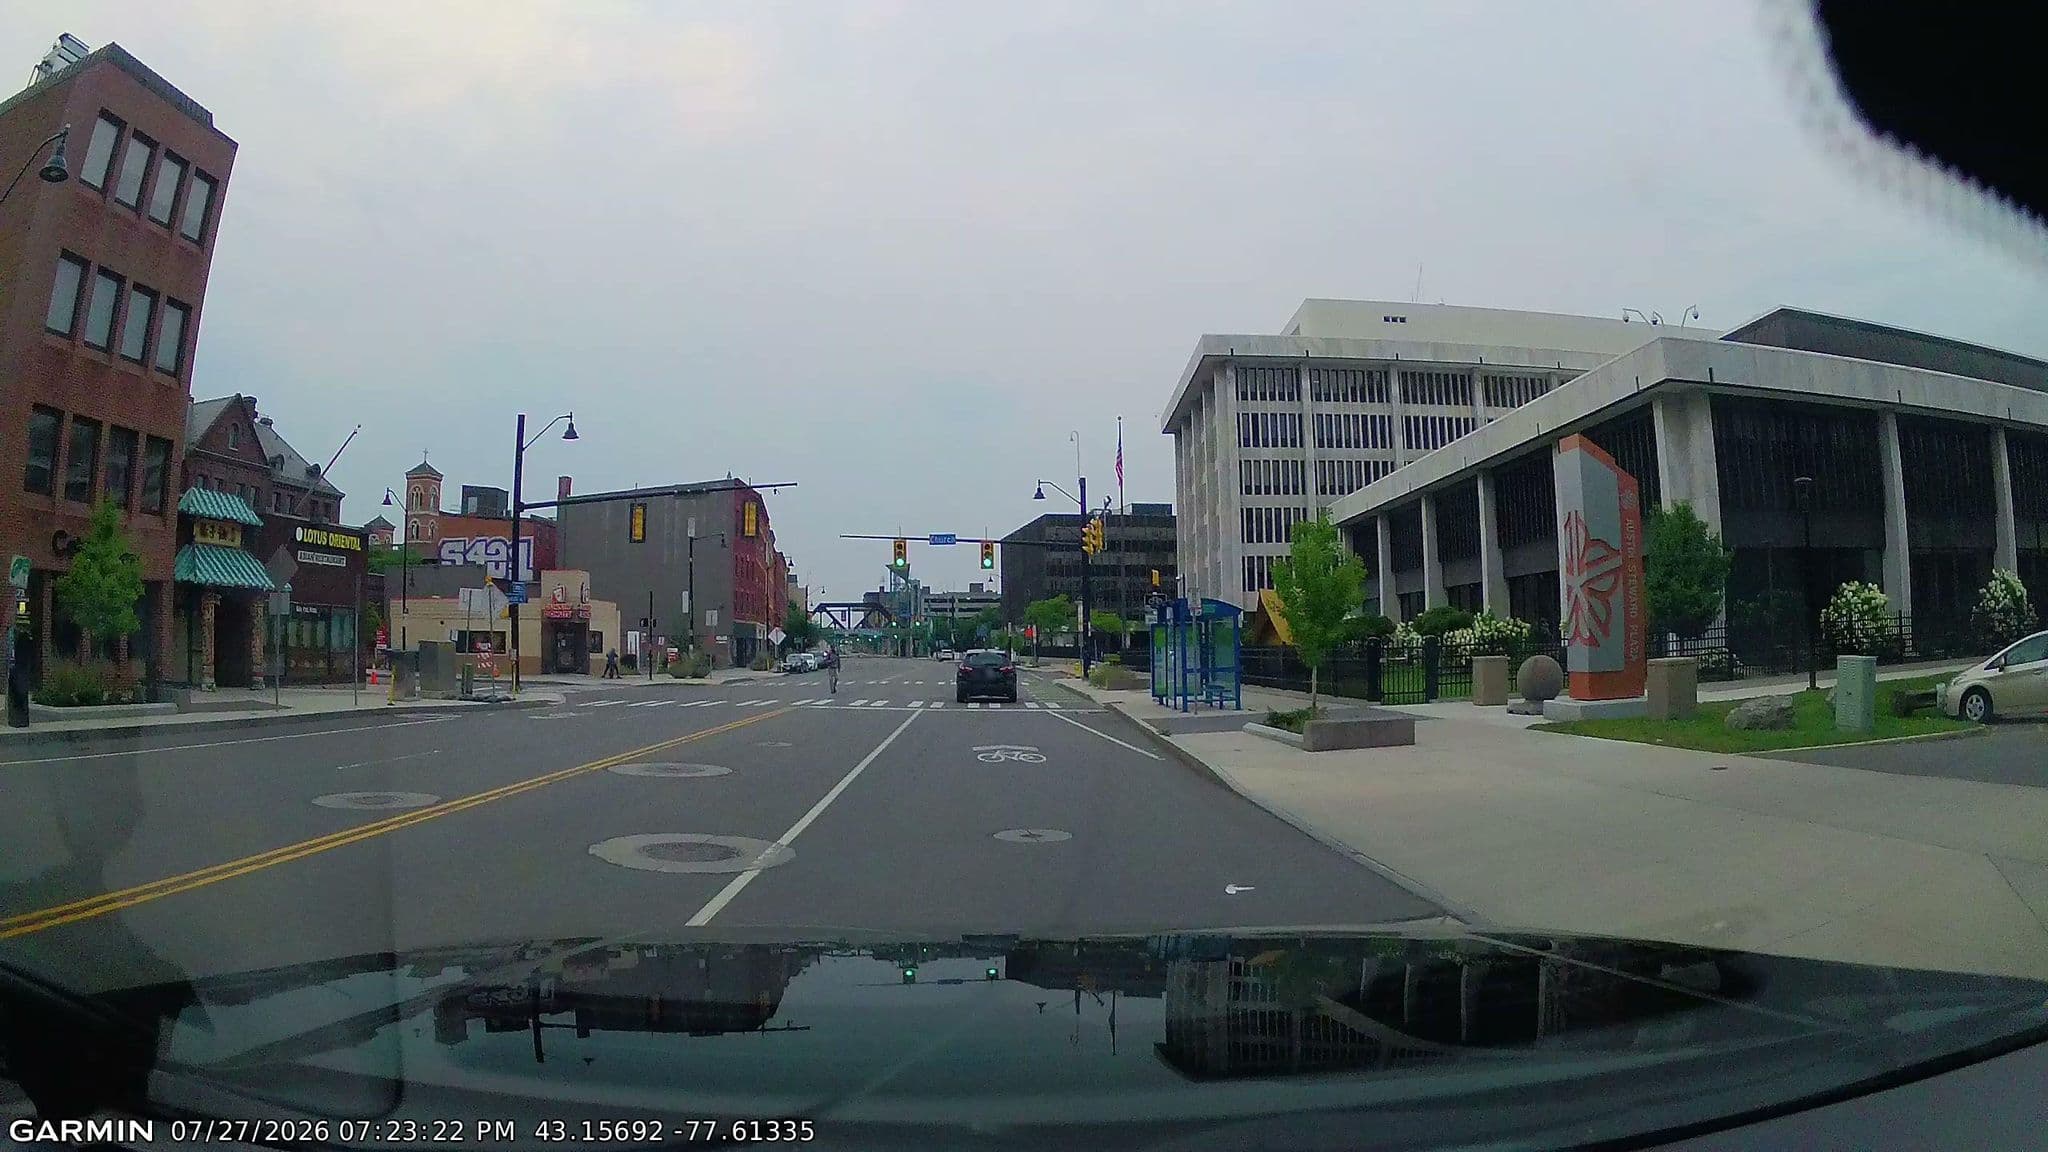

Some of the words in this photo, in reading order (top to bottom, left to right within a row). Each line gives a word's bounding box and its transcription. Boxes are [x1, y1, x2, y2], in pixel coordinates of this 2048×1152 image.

[303, 528, 328, 546] LOTUS
[328, 532, 362, 551] ORIENTAL
[930, 535, 956, 544] Church
[1628, 562, 1638, 618] STEWARD
[1630, 624, 1640, 661] PLAZA
